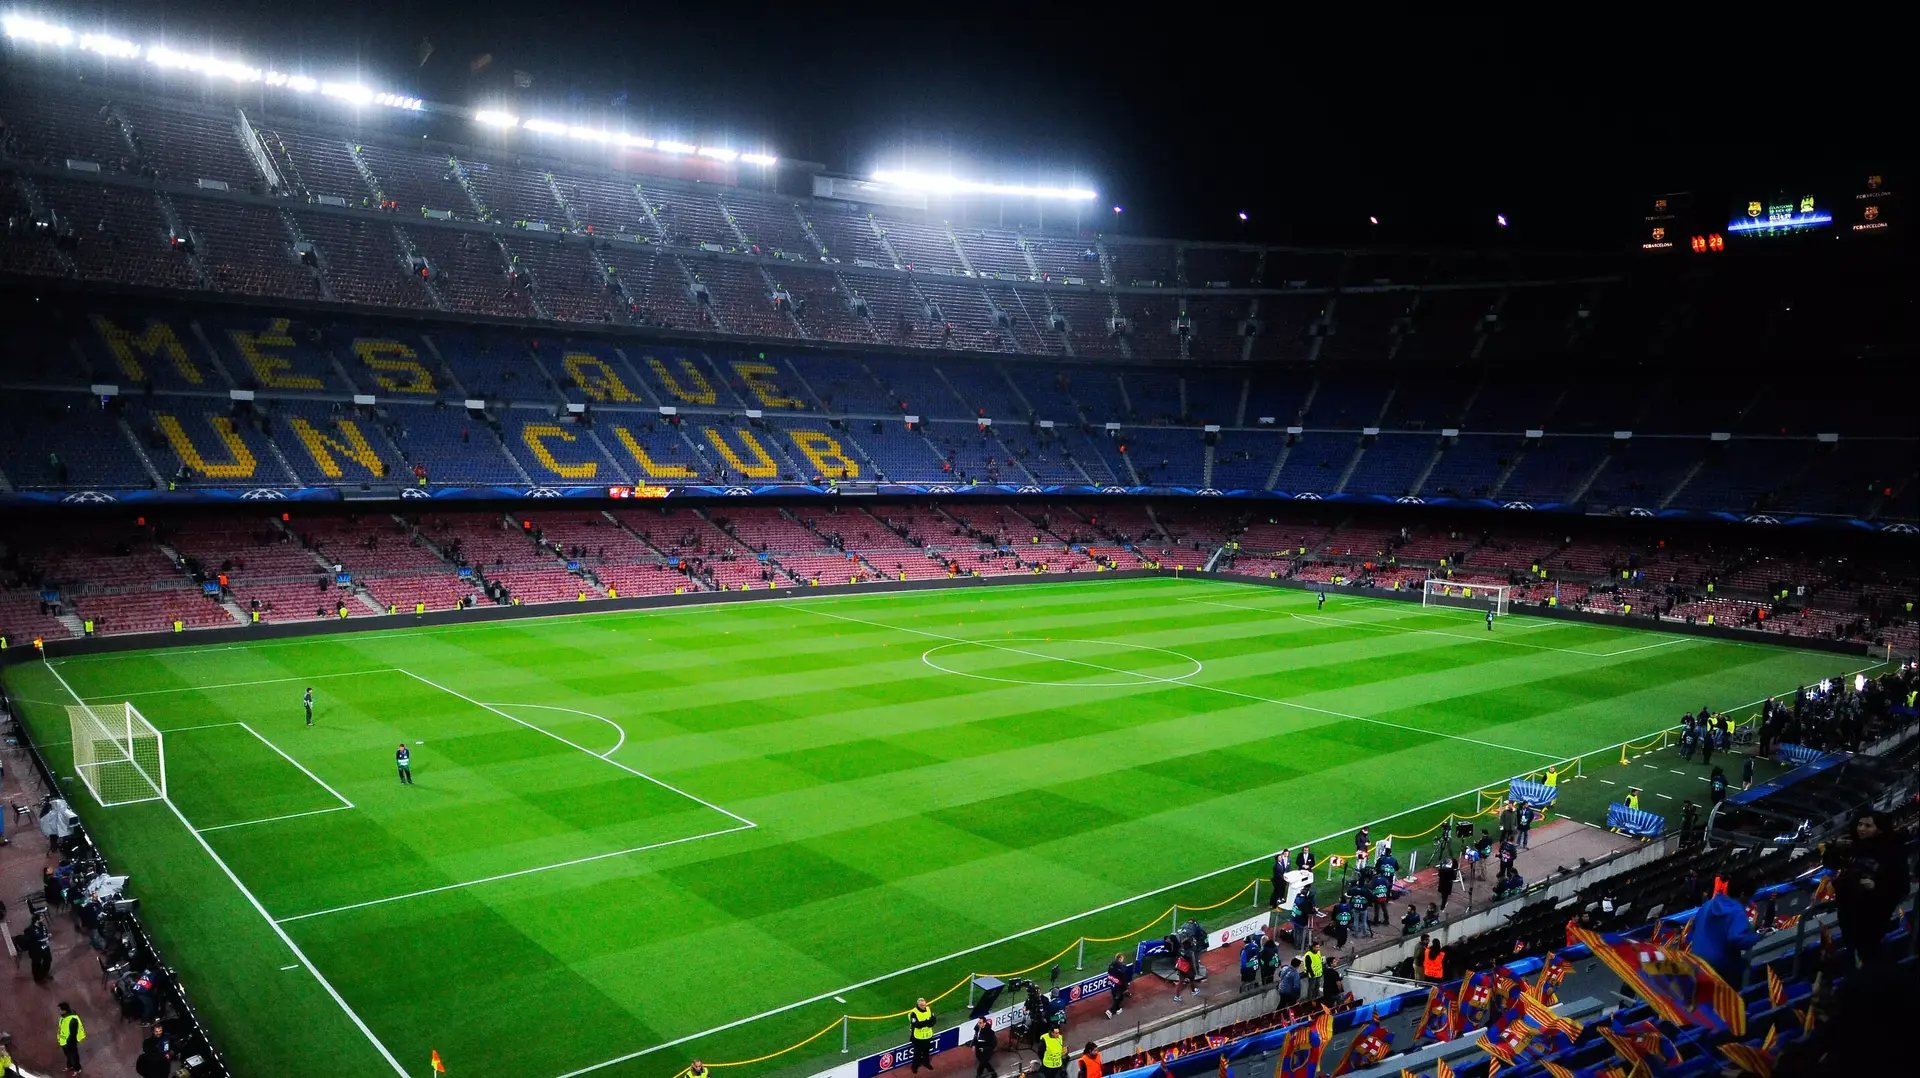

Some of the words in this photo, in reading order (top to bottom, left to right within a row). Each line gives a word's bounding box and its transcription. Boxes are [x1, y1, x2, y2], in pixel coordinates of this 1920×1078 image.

[1692, 236, 1706, 250] 19
[94, 315, 437, 395] MÉS
[563, 352, 805, 407] QUE
[157, 415, 385, 478] UN
[522, 424, 860, 478] CLUB
[1231, 920, 1258, 937] RESPECT
[1082, 977, 1108, 995] RESPE
[995, 1007, 1029, 1027] RESPEC
[895, 1038, 941, 1063] REST
